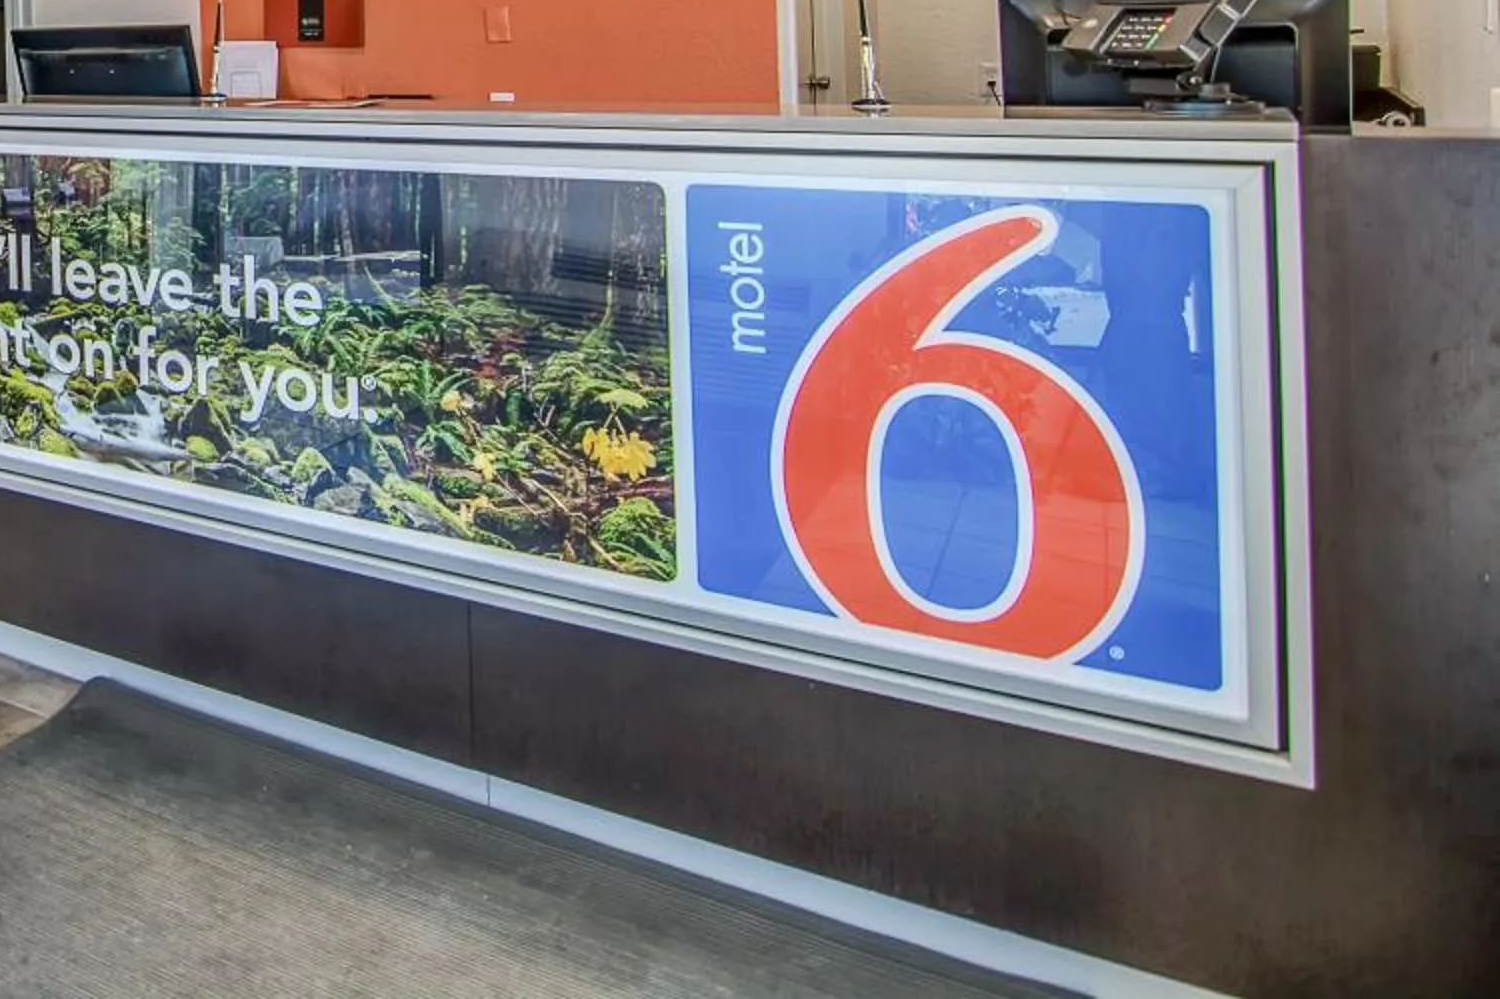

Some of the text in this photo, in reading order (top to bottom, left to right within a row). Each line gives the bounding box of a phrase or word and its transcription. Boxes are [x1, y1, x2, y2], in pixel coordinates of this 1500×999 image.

[51, 235, 193, 312] leave
[214, 254, 324, 326] the
[49, 329, 114, 381] on
[134, 325, 219, 397] for
[718, 204, 1146, 666] motel 6
